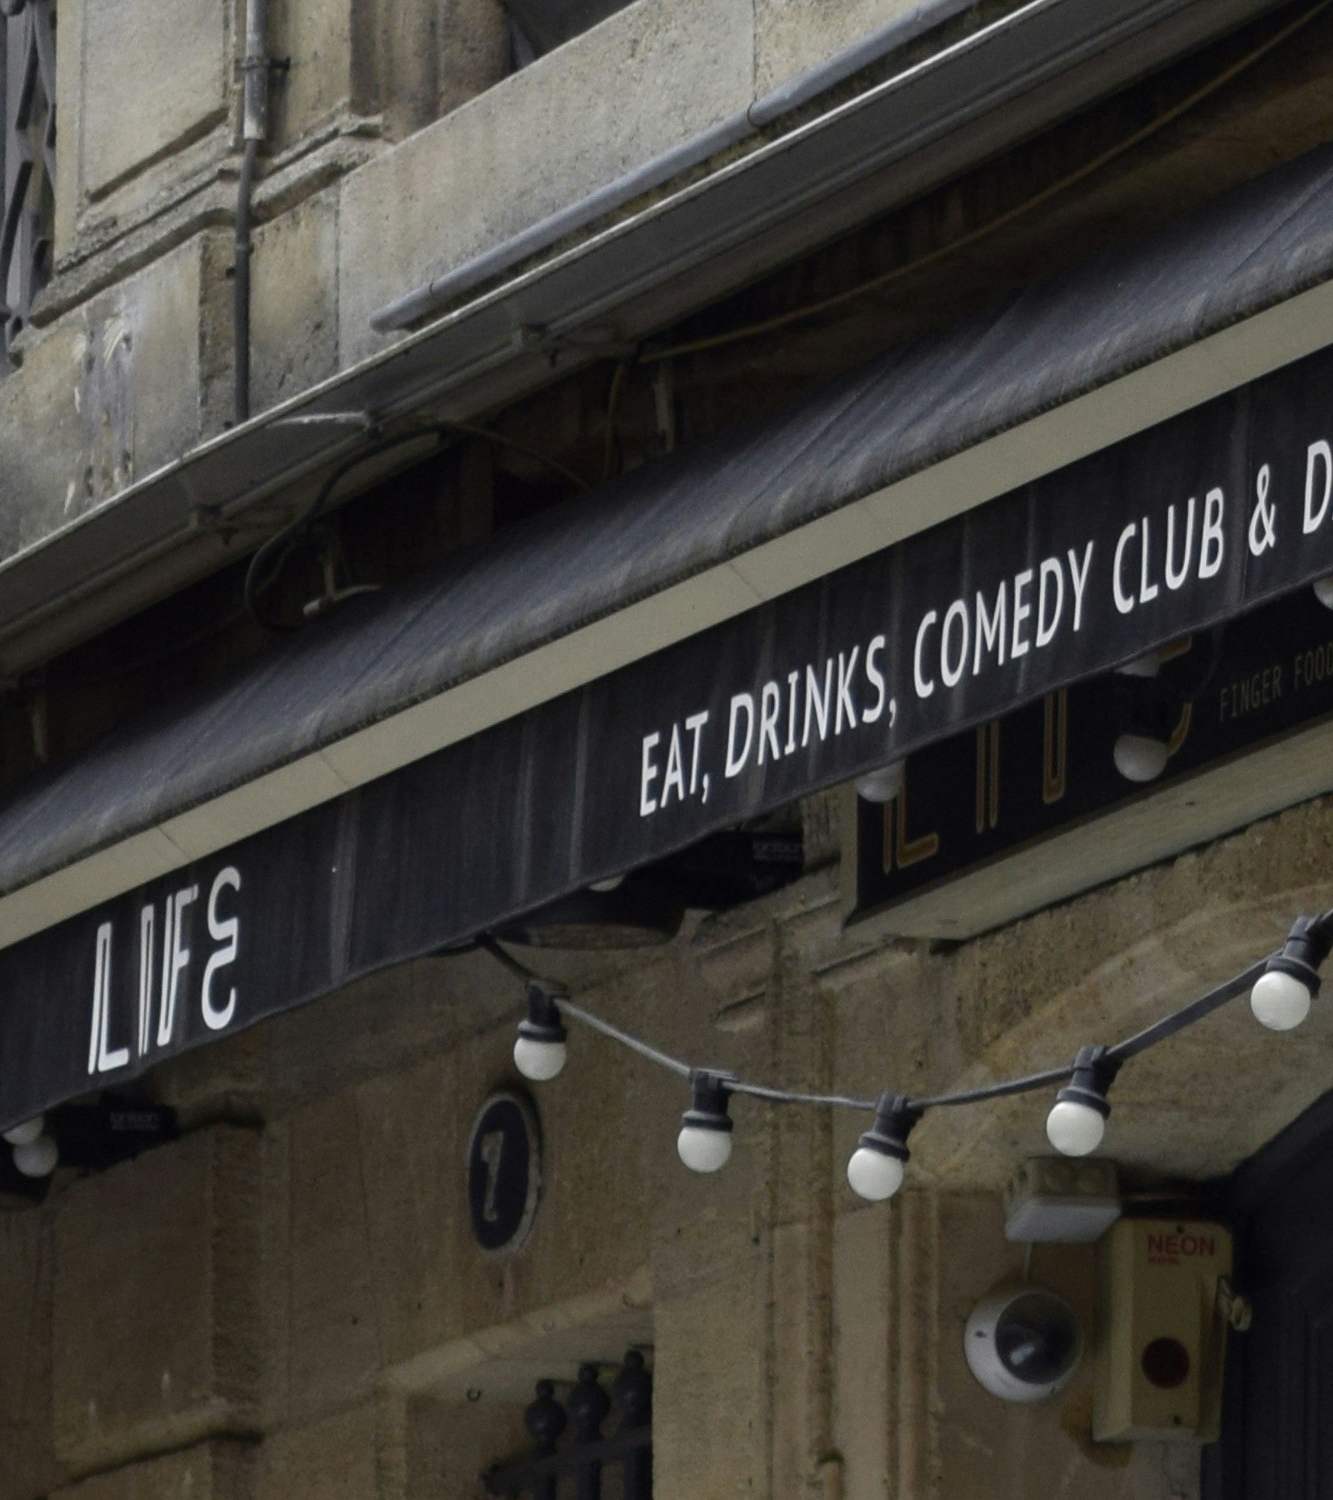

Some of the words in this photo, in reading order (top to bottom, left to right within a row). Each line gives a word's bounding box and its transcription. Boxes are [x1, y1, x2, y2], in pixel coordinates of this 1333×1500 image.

[639, 709, 710, 817] EAT,
[724, 634, 898, 779] DRINKS,
[913, 540, 1094, 699] COMEDY
[1112, 486, 1225, 615] CLUB
[1247, 463, 1277, 557] &
[1301, 439, 1333, 535] D
[1219, 664, 1283, 723] FINGER
[87, 867, 241, 1076] LIFE
[1146, 1233, 1215, 1257] NEON
